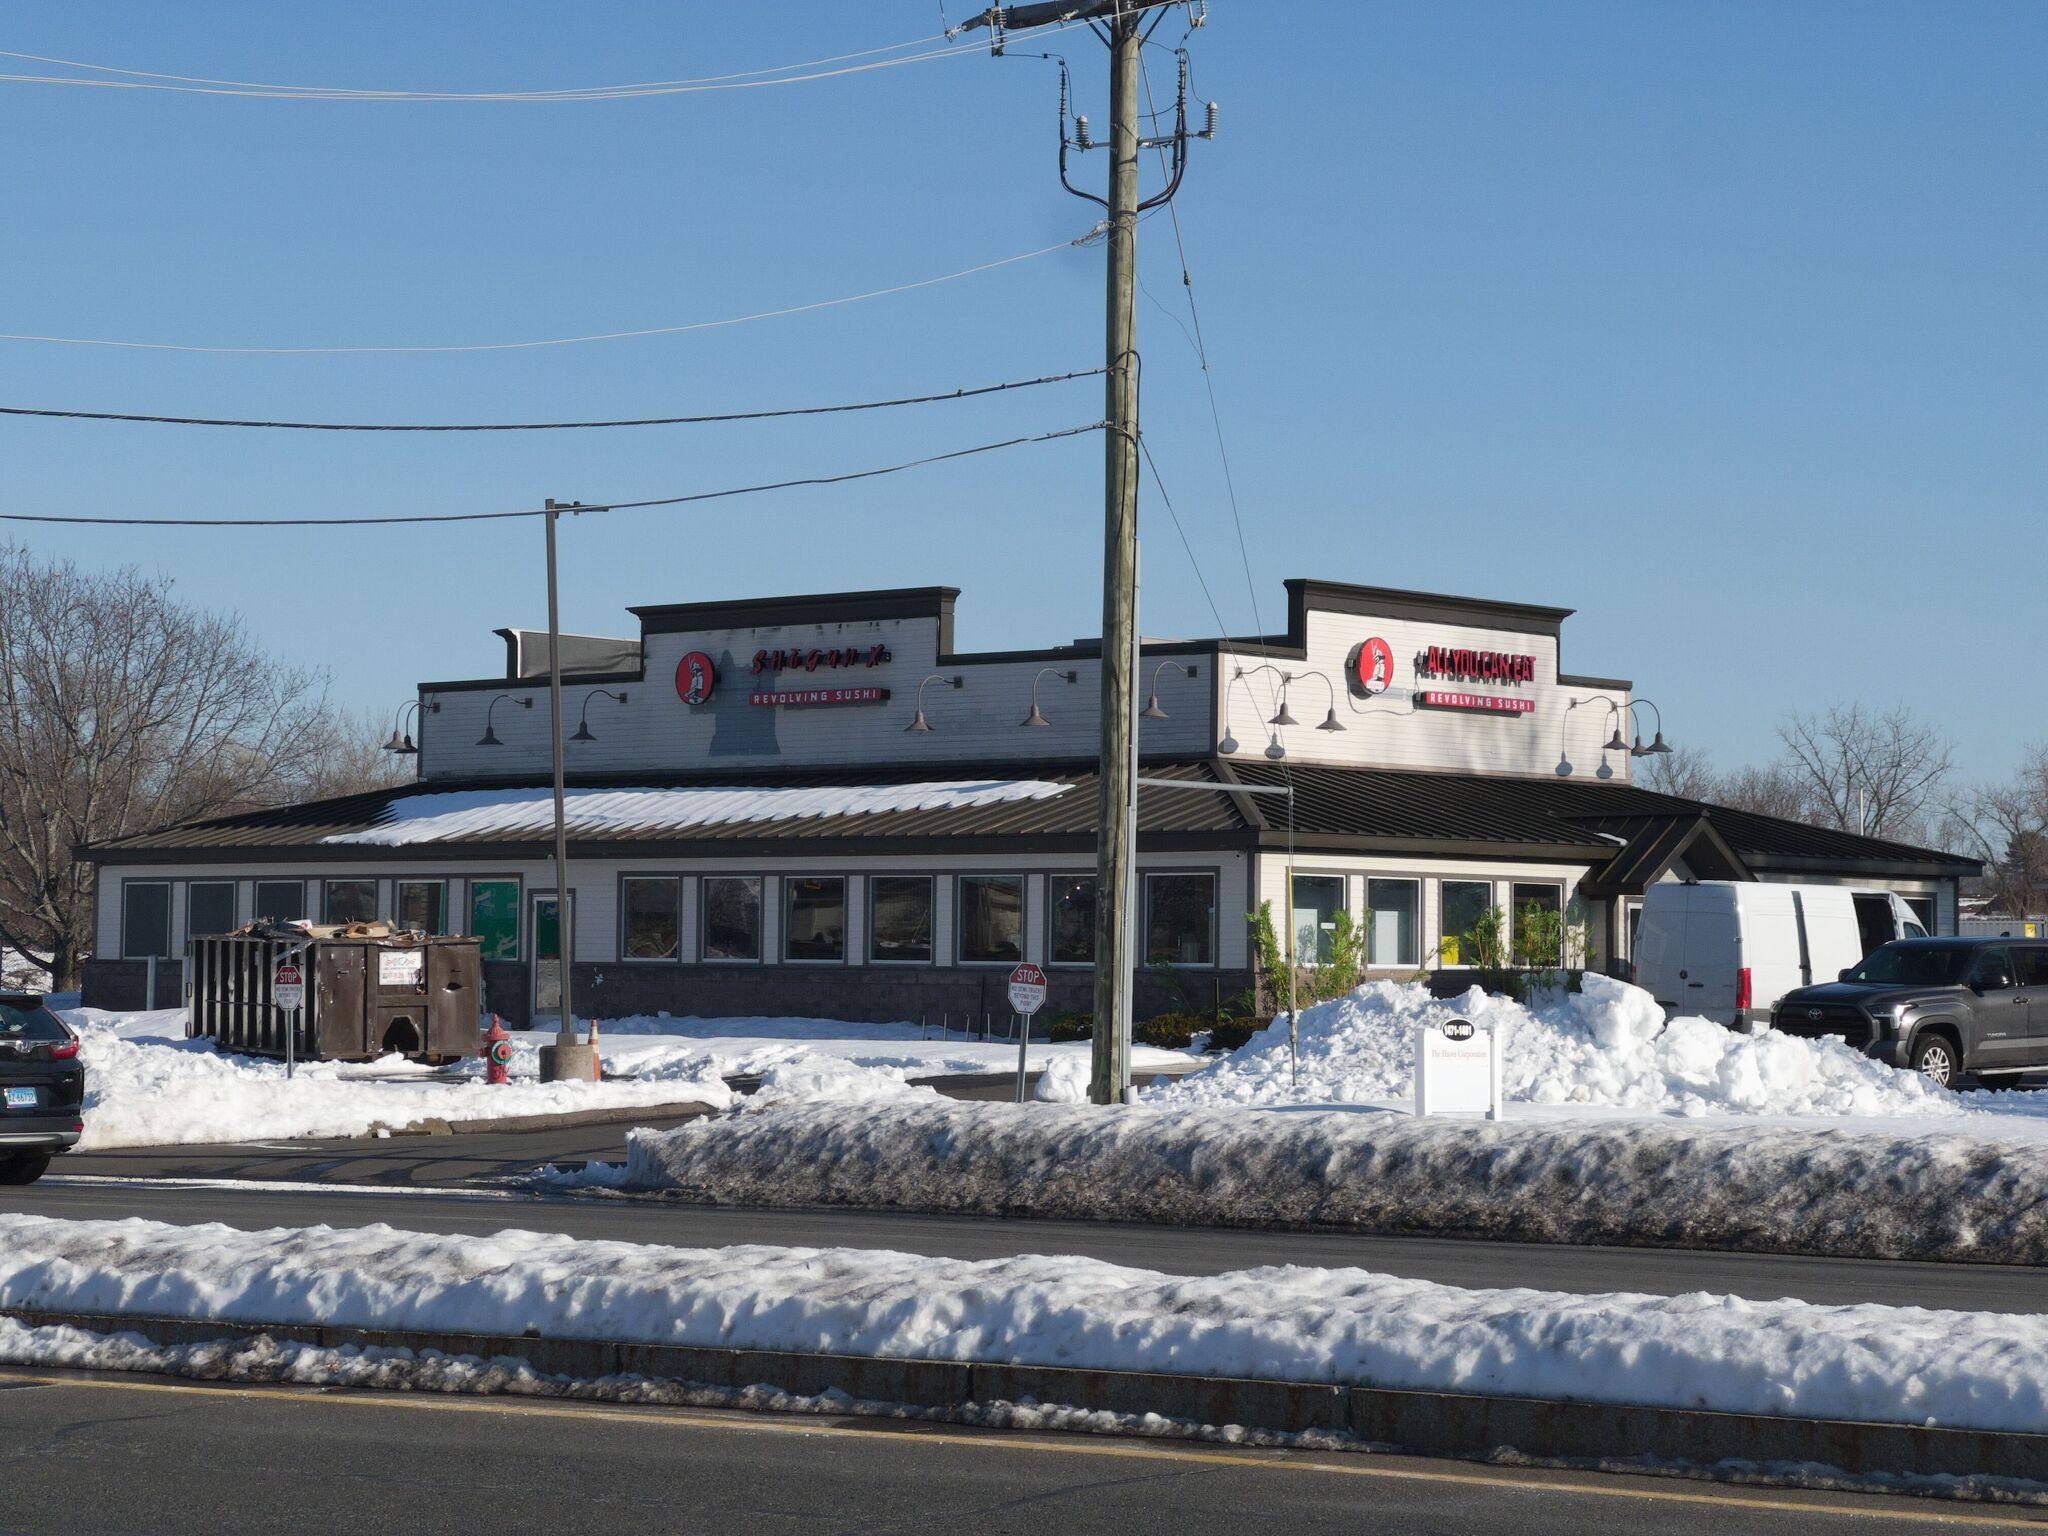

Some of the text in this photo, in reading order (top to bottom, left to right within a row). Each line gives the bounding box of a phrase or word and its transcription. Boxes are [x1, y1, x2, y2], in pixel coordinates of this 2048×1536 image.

[1428, 646, 1537, 682] ALL YOU CAN EAT
[754, 689, 876, 704] REVOLVING SUSHI
[1430, 692, 1530, 711] REVOLVING SUSHI
[279, 971, 297, 983] STOP
[1017, 969, 1040, 983] STOP
